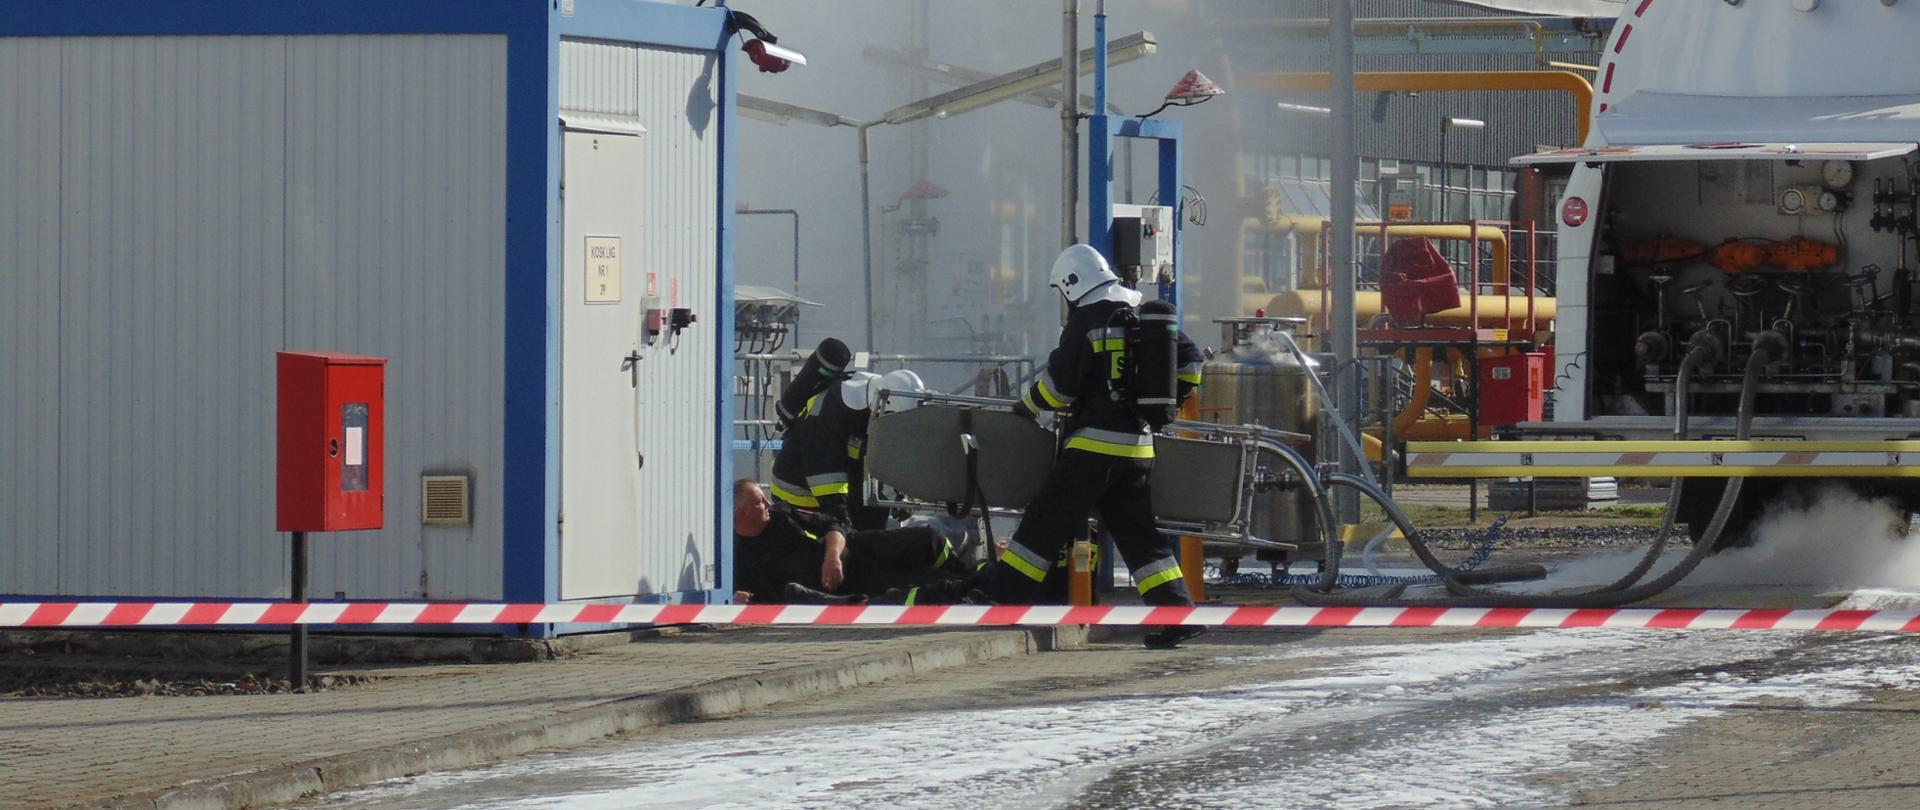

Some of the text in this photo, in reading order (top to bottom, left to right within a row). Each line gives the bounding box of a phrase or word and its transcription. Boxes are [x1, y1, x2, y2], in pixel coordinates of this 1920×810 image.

[591, 246, 616, 259] KIOSK LNG
[598, 265, 605, 277] NR
